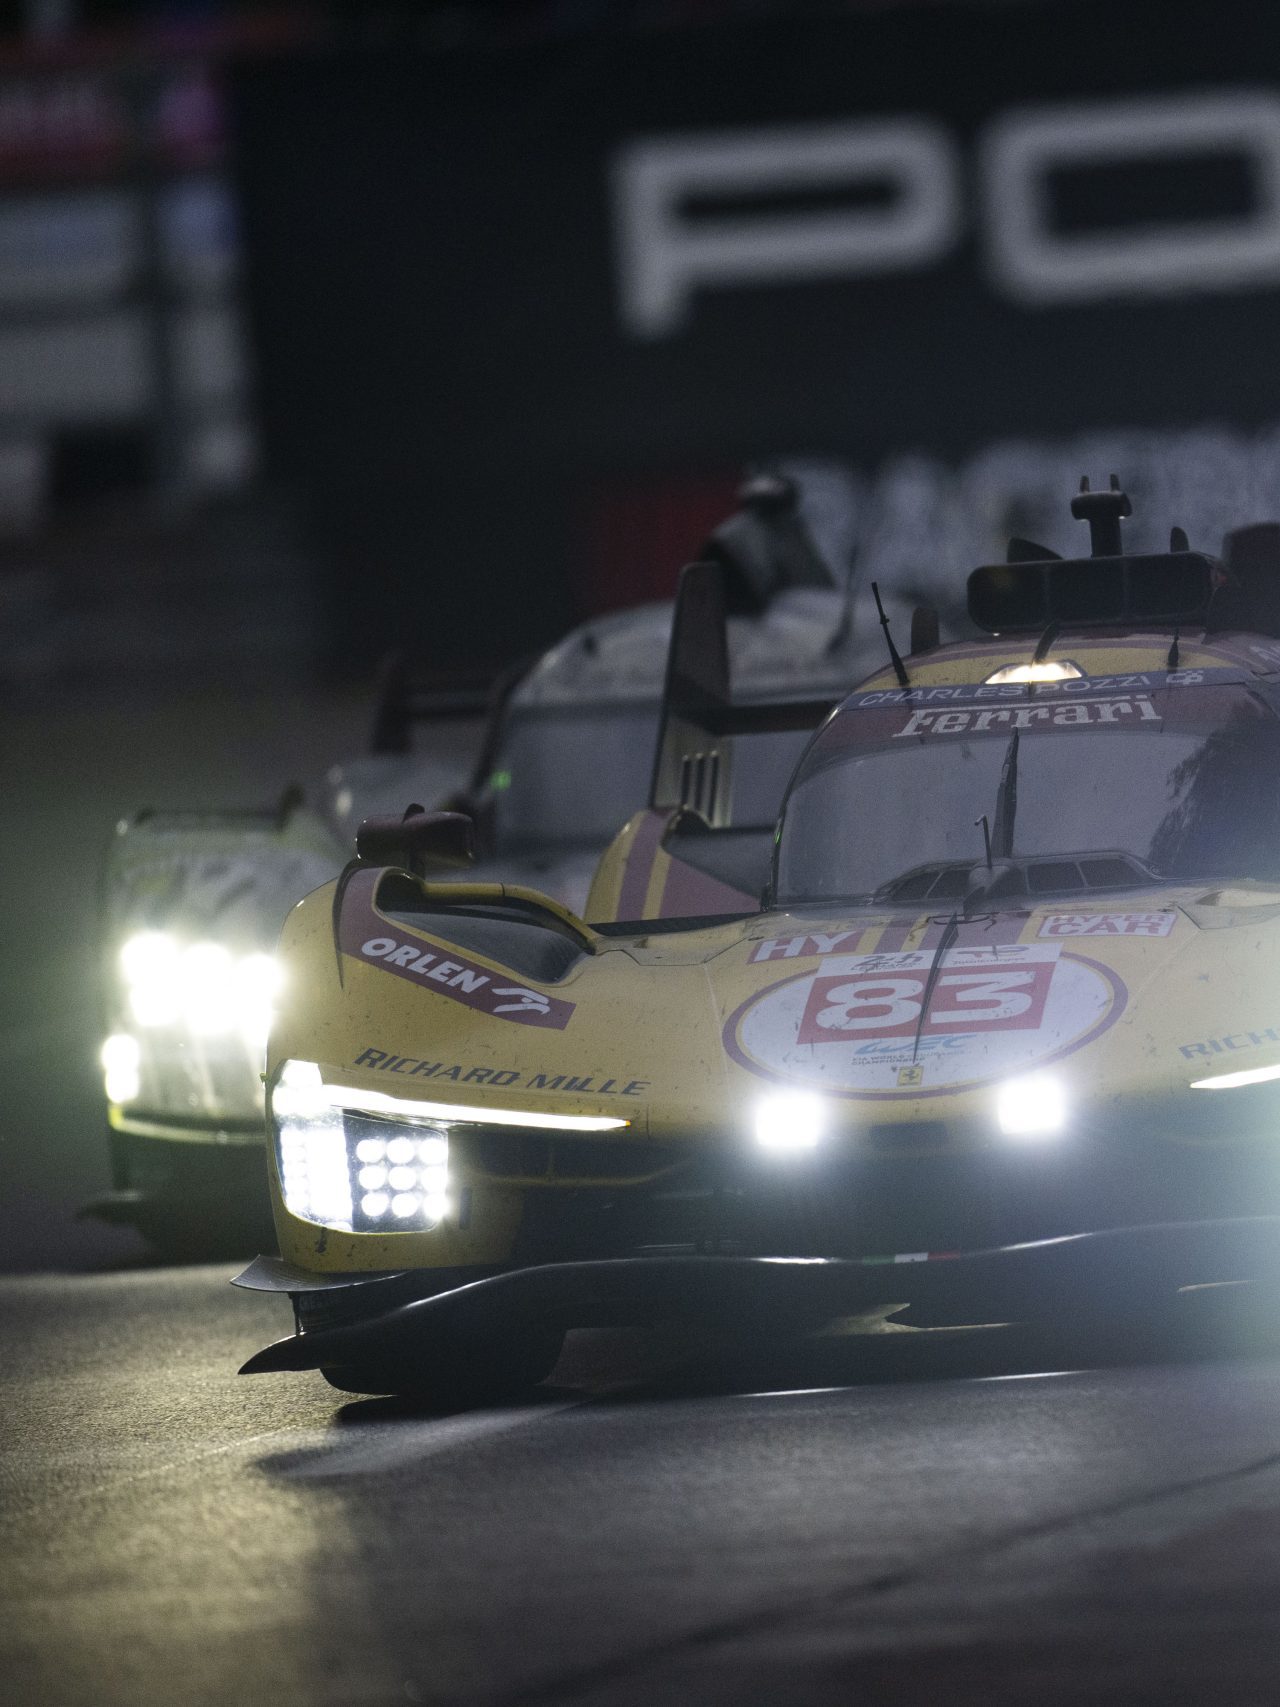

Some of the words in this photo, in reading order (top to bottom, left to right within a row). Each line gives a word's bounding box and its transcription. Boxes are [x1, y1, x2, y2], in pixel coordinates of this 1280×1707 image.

[858, 685, 1026, 707] CHARLES
[1038, 676, 1150, 694] POZZI
[891, 694, 1162, 738] Ferrari
[1048, 920, 1162, 935] CAR
[1052, 914, 1166, 924] HYPER
[753, 931, 858, 962] HY
[361, 937, 490, 993] ORLEN
[815, 970, 1036, 1031] 83
[854, 1034, 977, 1055] WEC
[353, 1047, 521, 1087] RICHARD
[525, 1073, 651, 1096] MILLE
